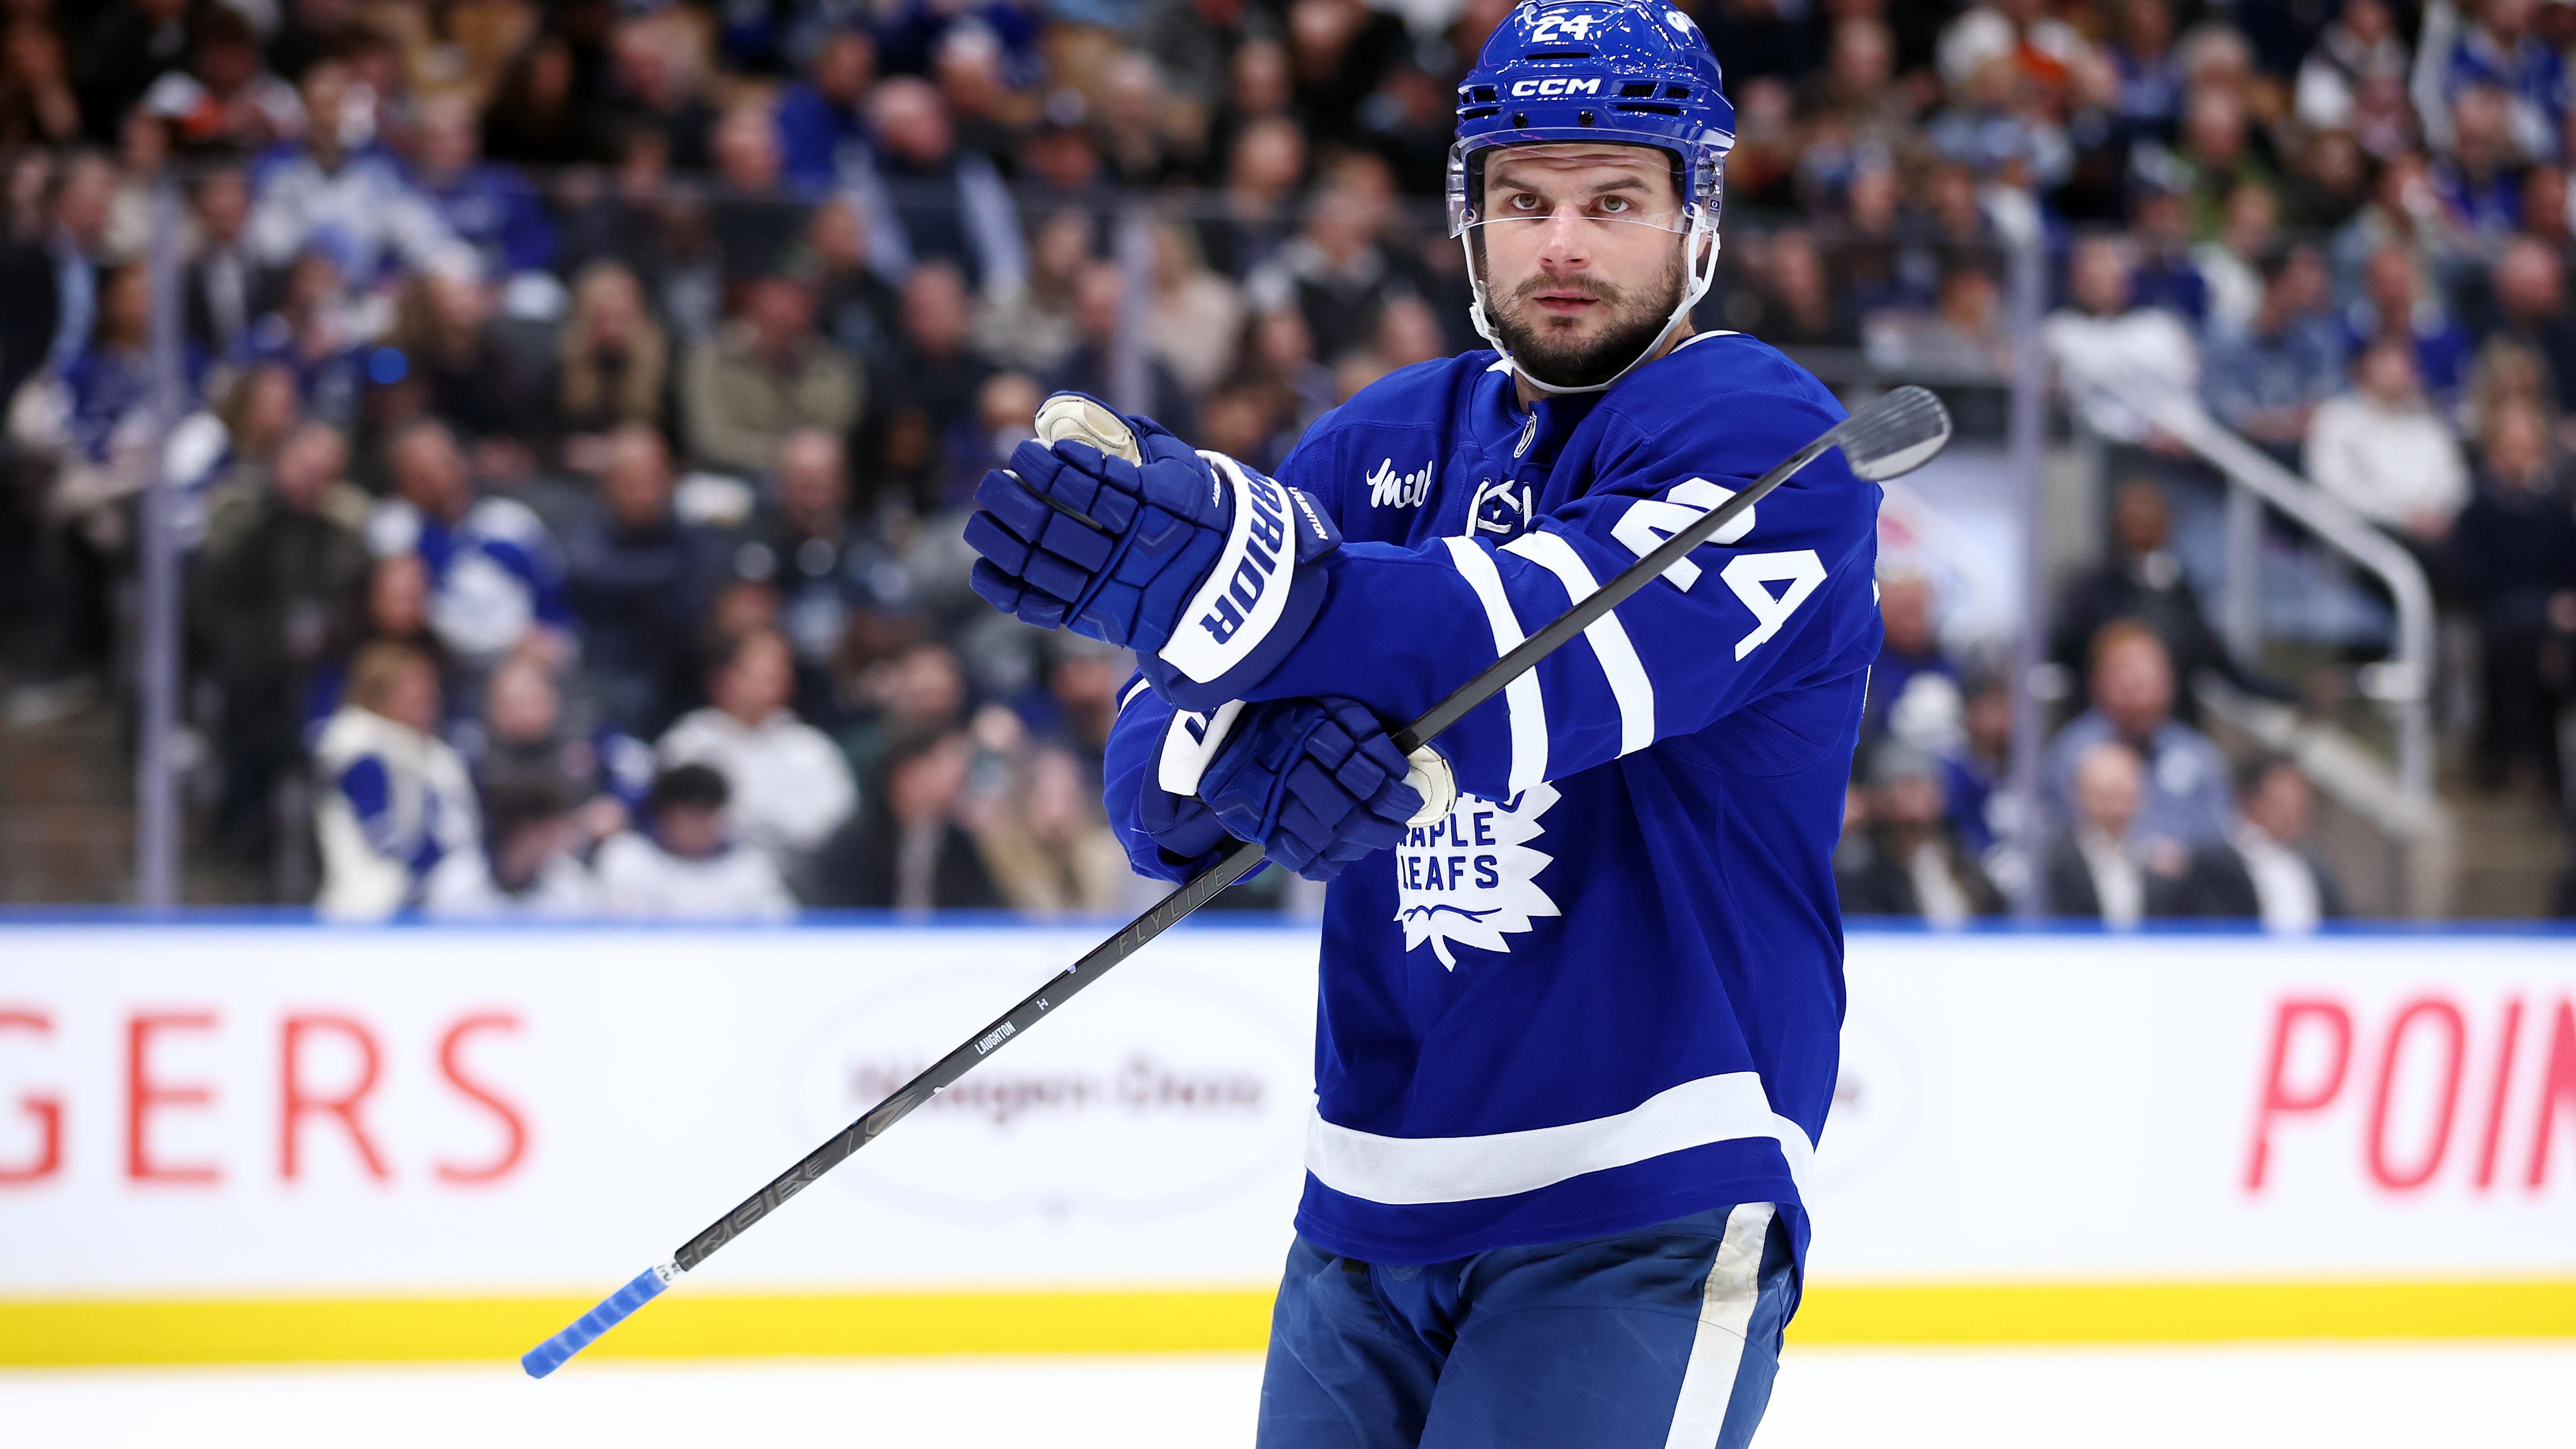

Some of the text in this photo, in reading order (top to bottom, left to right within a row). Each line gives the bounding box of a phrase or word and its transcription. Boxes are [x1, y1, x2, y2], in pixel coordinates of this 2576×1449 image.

[1531, 14, 1592, 43] 24
[1510, 78, 1601, 97] CCM
[1287, 486, 1329, 541] LAUGHTON
[1199, 471, 1285, 646] RRIOR
[1610, 476, 1828, 662] 24
[1399, 811, 1496, 848] APLE
[1117, 863, 1226, 957] FLYLITE
[974, 1021, 1016, 1055] LAUGHTON
